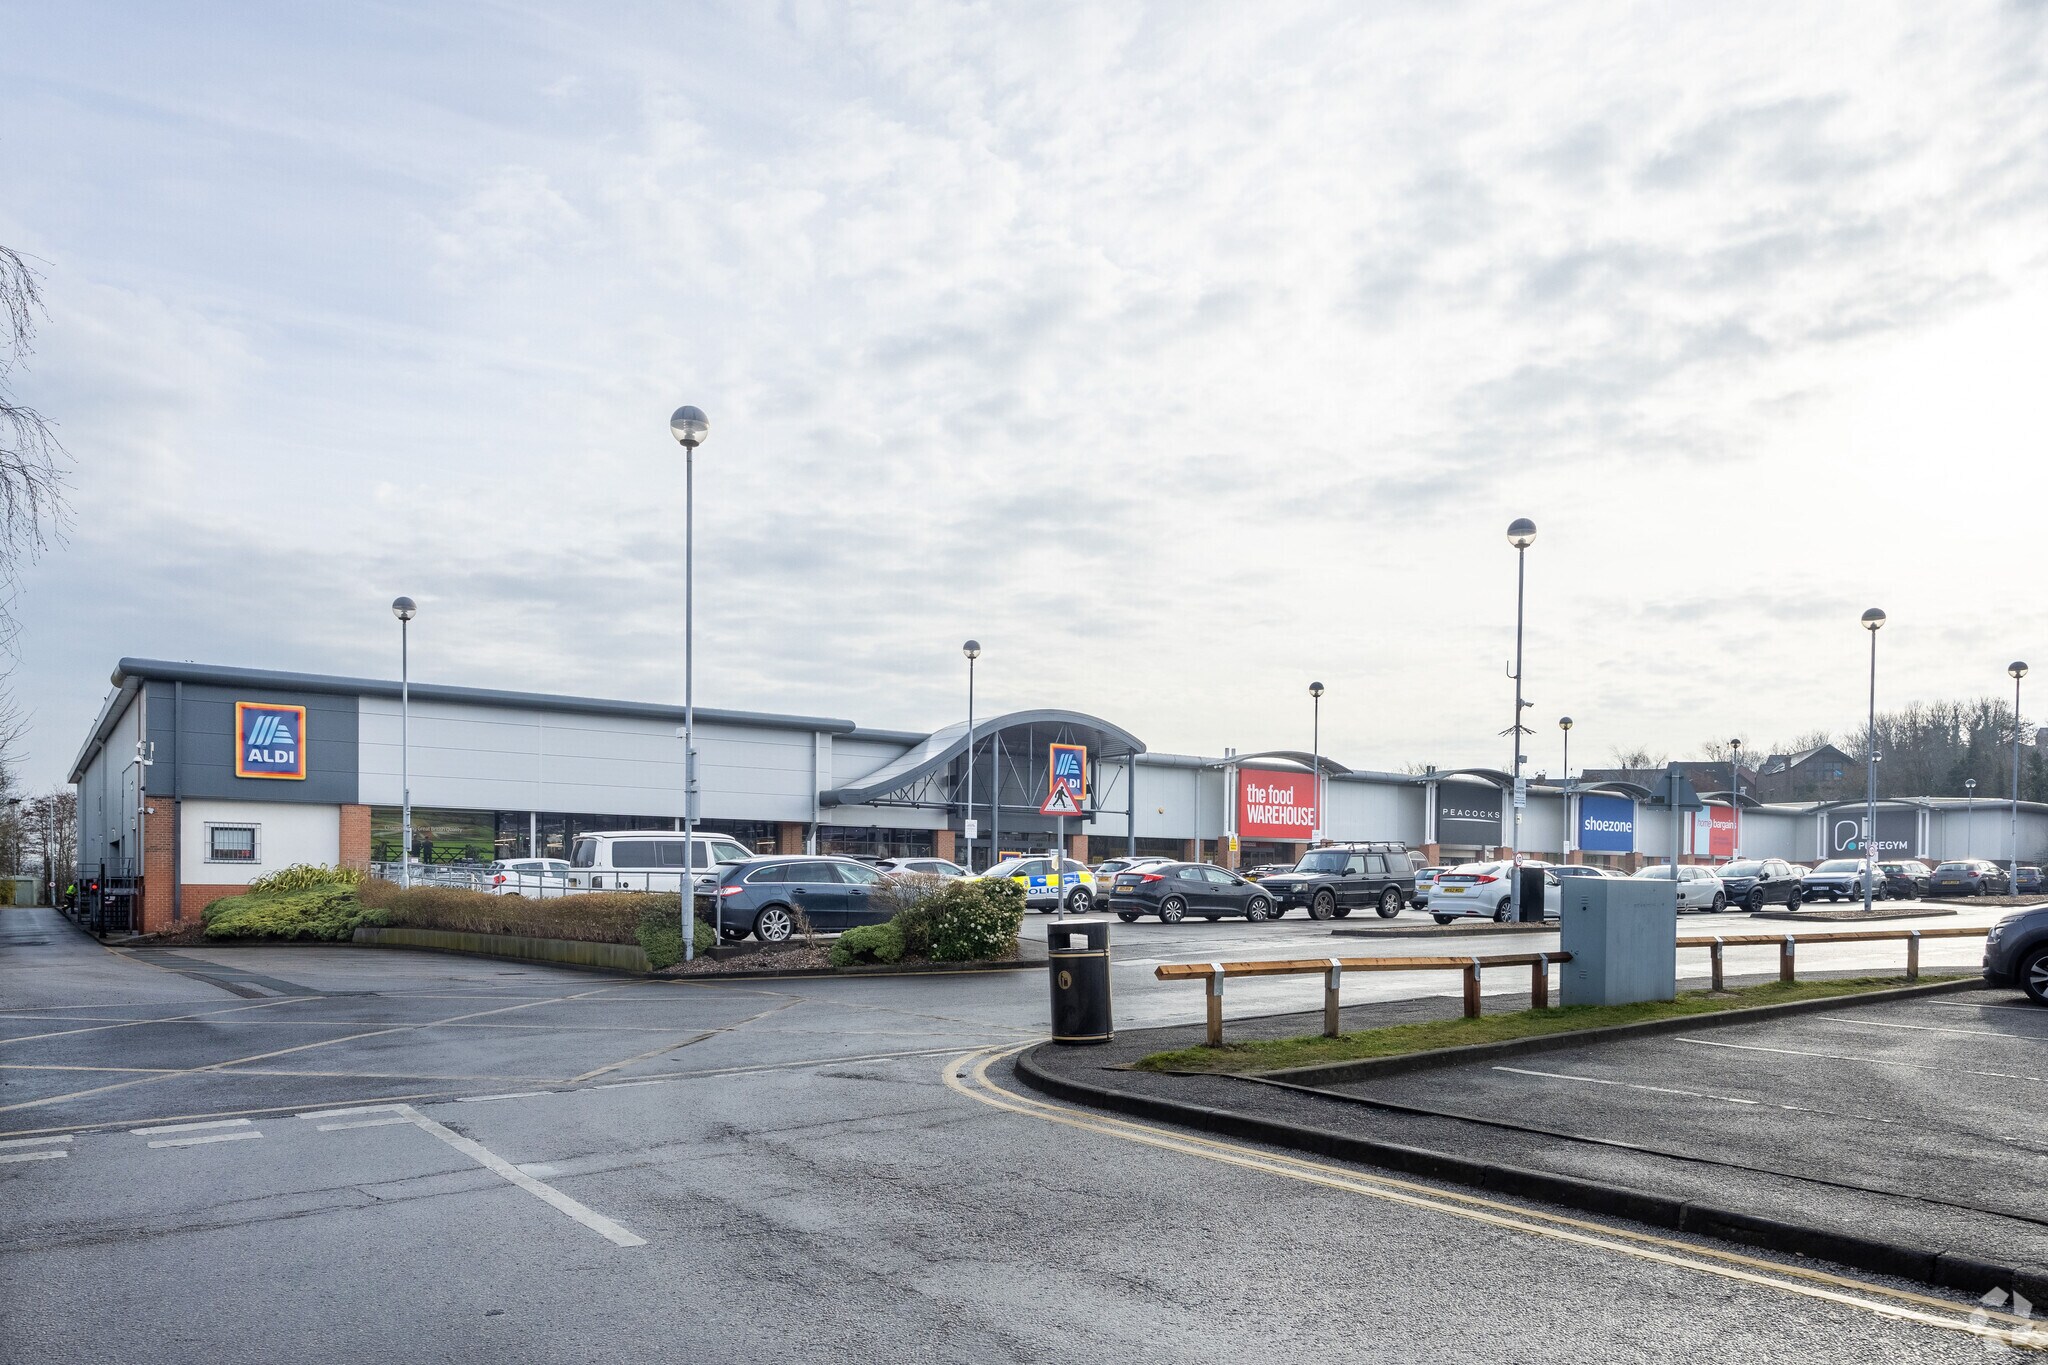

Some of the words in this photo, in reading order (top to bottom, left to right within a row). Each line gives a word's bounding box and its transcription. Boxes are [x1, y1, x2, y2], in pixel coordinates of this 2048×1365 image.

[247, 748, 295, 764] ALDI
[1057, 778, 1080, 788] DI
[1247, 783, 1266, 803] the
[1268, 784, 1294, 805] food
[1246, 804, 1315, 826] WAREHOUSE
[1442, 808, 1501, 818] PEACOCKS
[1584, 816, 1632, 833] shoezone
[1028, 886, 1068, 895] OLICE
